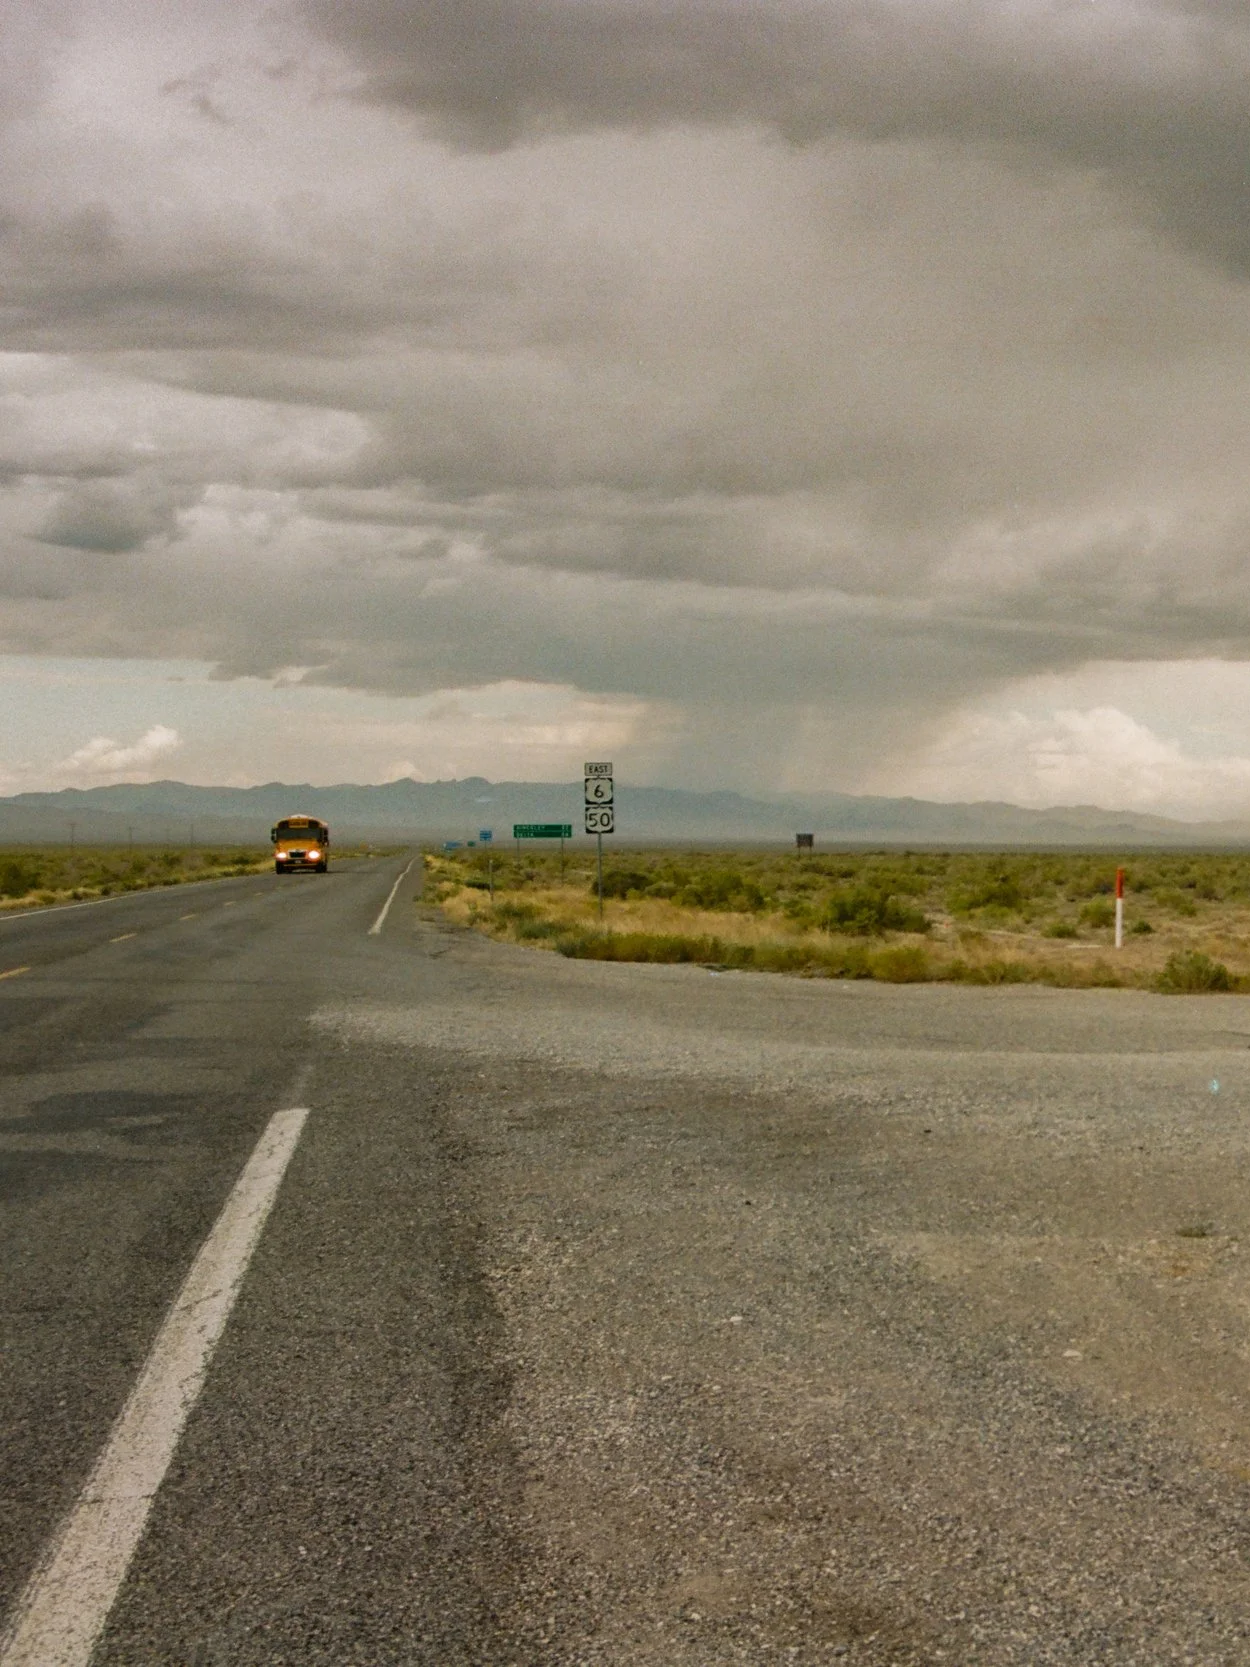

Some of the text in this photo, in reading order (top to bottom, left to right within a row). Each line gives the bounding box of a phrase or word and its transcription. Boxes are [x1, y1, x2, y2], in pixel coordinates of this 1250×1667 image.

[588, 765, 608, 774] EAST
[593, 784, 604, 798] 6
[588, 812, 610, 828] 50
